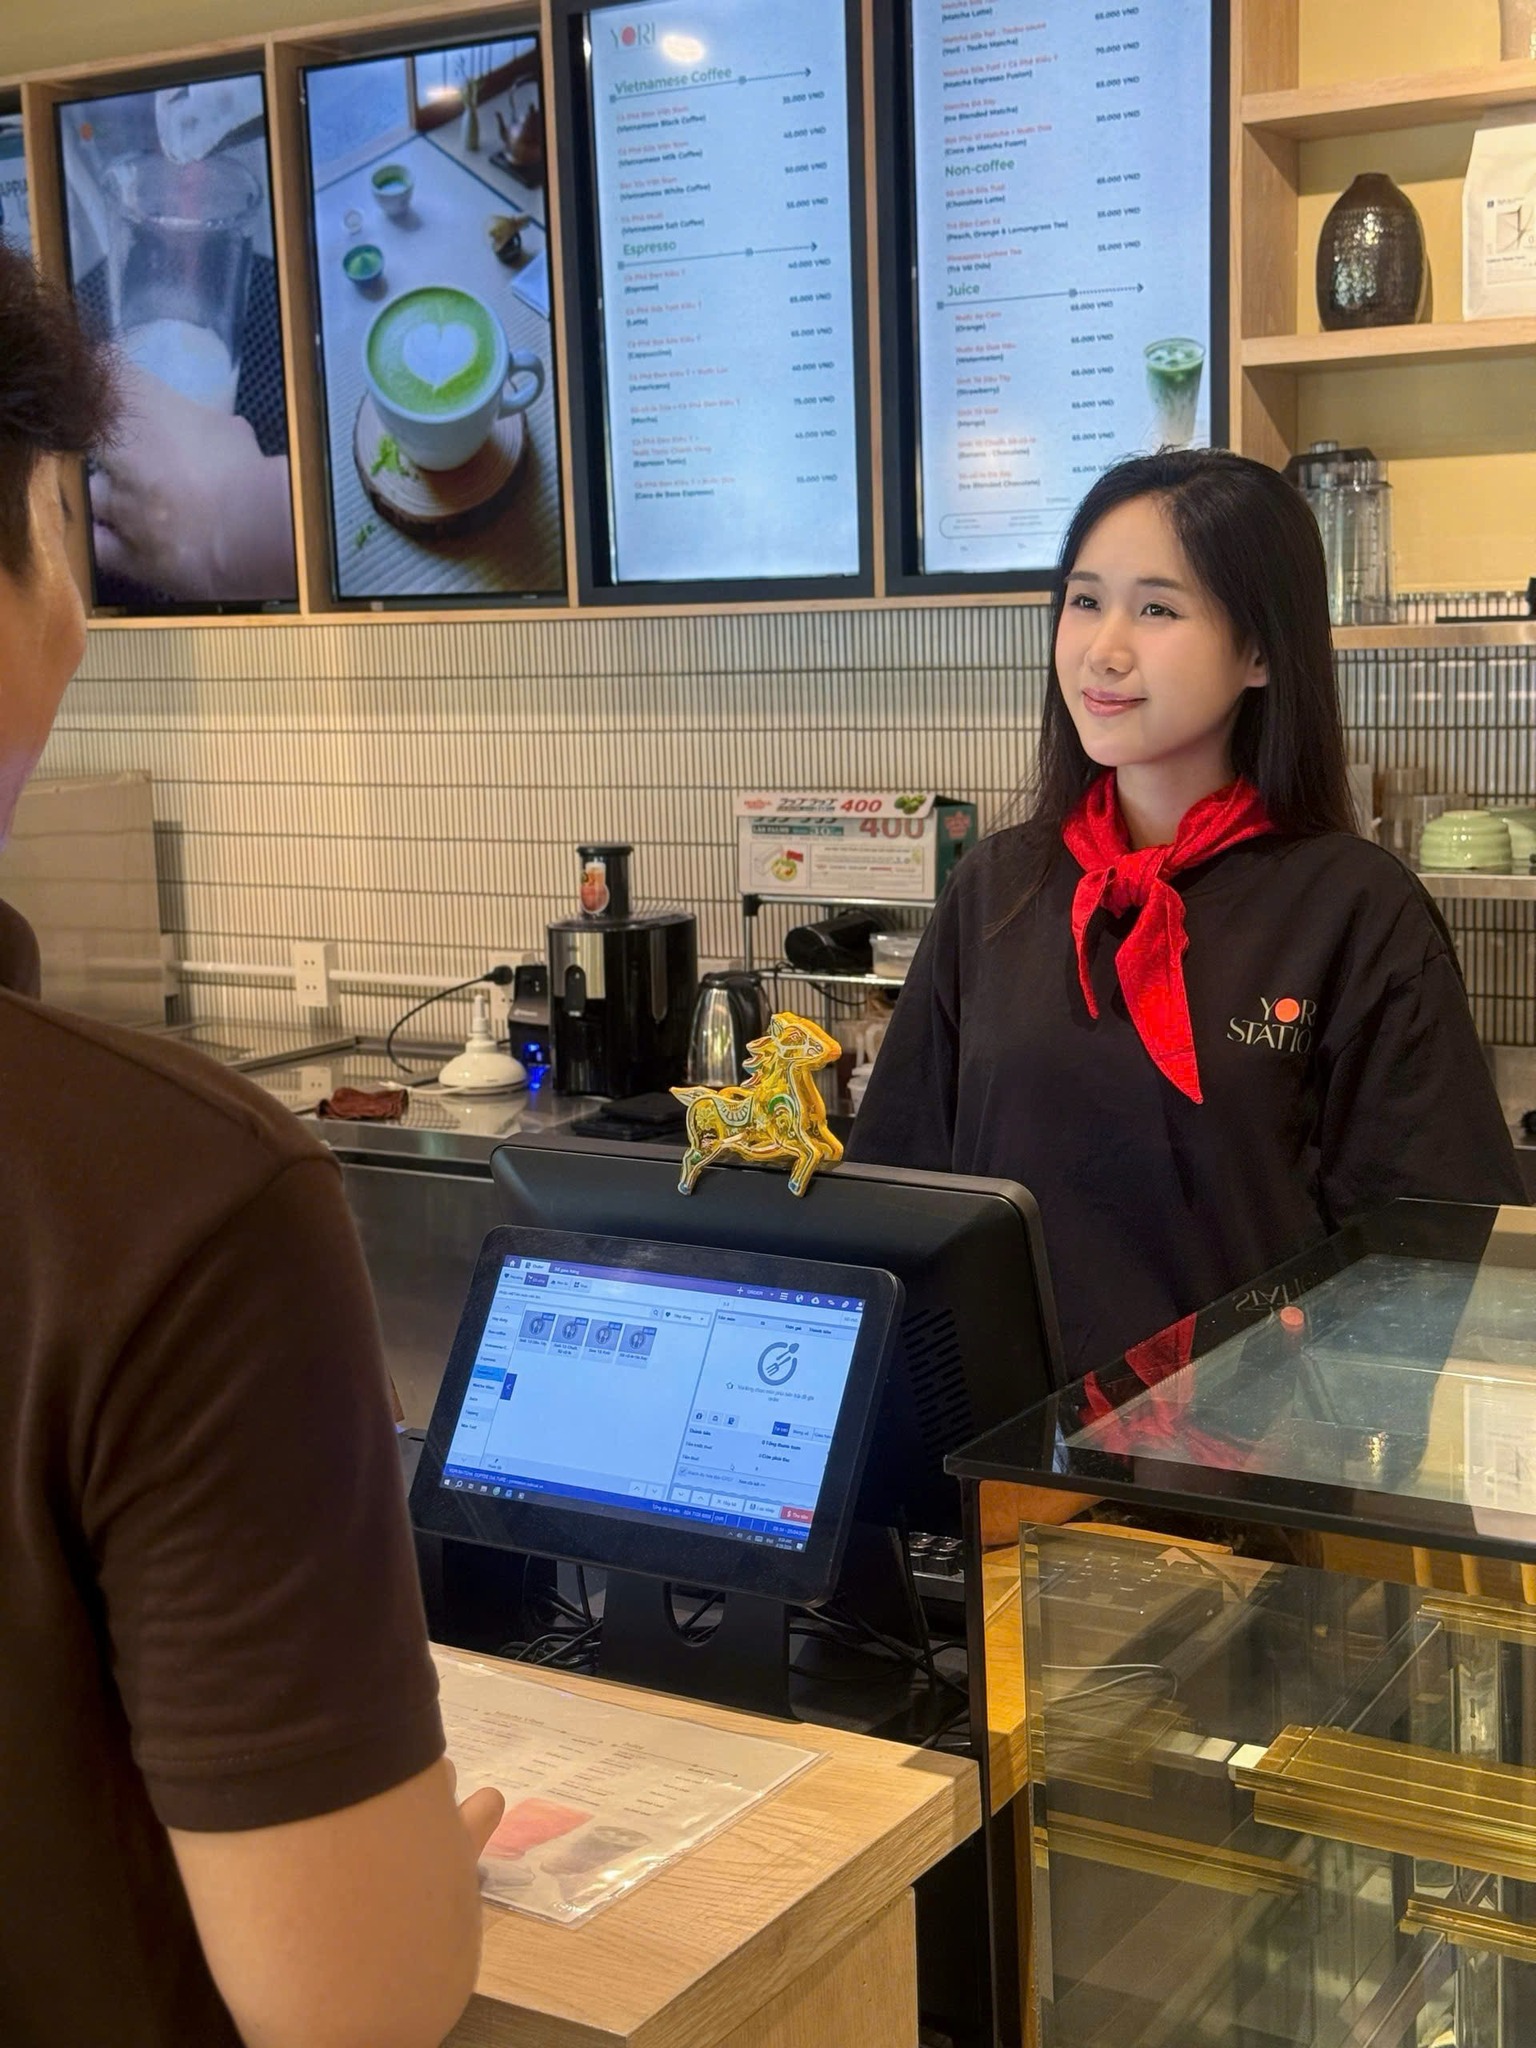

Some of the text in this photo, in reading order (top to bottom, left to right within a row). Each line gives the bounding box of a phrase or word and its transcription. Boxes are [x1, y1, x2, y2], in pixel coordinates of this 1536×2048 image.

[1121, 7, 1139, 16] VND
[610, 22, 655, 50] YORI
[1122, 41, 1140, 50] VND
[615, 66, 732, 94] Vietnamese Coffee
[1122, 76, 1140, 85] VND
[808, 91, 825, 100] VND
[989, 106, 1018, 116] Matcha)
[1123, 110, 1140, 119] VND
[681, 115, 706, 124] Coffee)
[809, 126, 826, 135] VND
[678, 149, 703, 159] Coffee)
[810, 161, 827, 170] VND
[945, 159, 1015, 178] Non-coffee
[1123, 173, 1141, 181] VND
[686, 183, 711, 192] Coffee)
[811, 197, 828, 205] VND
[1123, 207, 1141, 215] VND
[680, 219, 705, 228] Coffee)
[973, 230, 1000, 238] Orange
[1123, 240, 1141, 248] VND
[623, 240, 677, 258] Espresso
[814, 258, 831, 266] VND
[947, 283, 980, 297] Juice
[815, 292, 832, 300] VND
[1096, 300, 1113, 309] VND
[816, 327, 833, 335] VND
[955, 323, 986, 333] (Orange)
[1096, 333, 1114, 341] VND
[818, 361, 835, 369] VND
[1097, 366, 1114, 374] VND
[818, 395, 835, 403] VND
[1097, 399, 1114, 407] VND
[820, 429, 837, 437] VND
[1098, 431, 1115, 439] VND
[821, 474, 838, 482] VND
[840, 799, 883, 813] 400
[859, 817, 925, 839] 400
